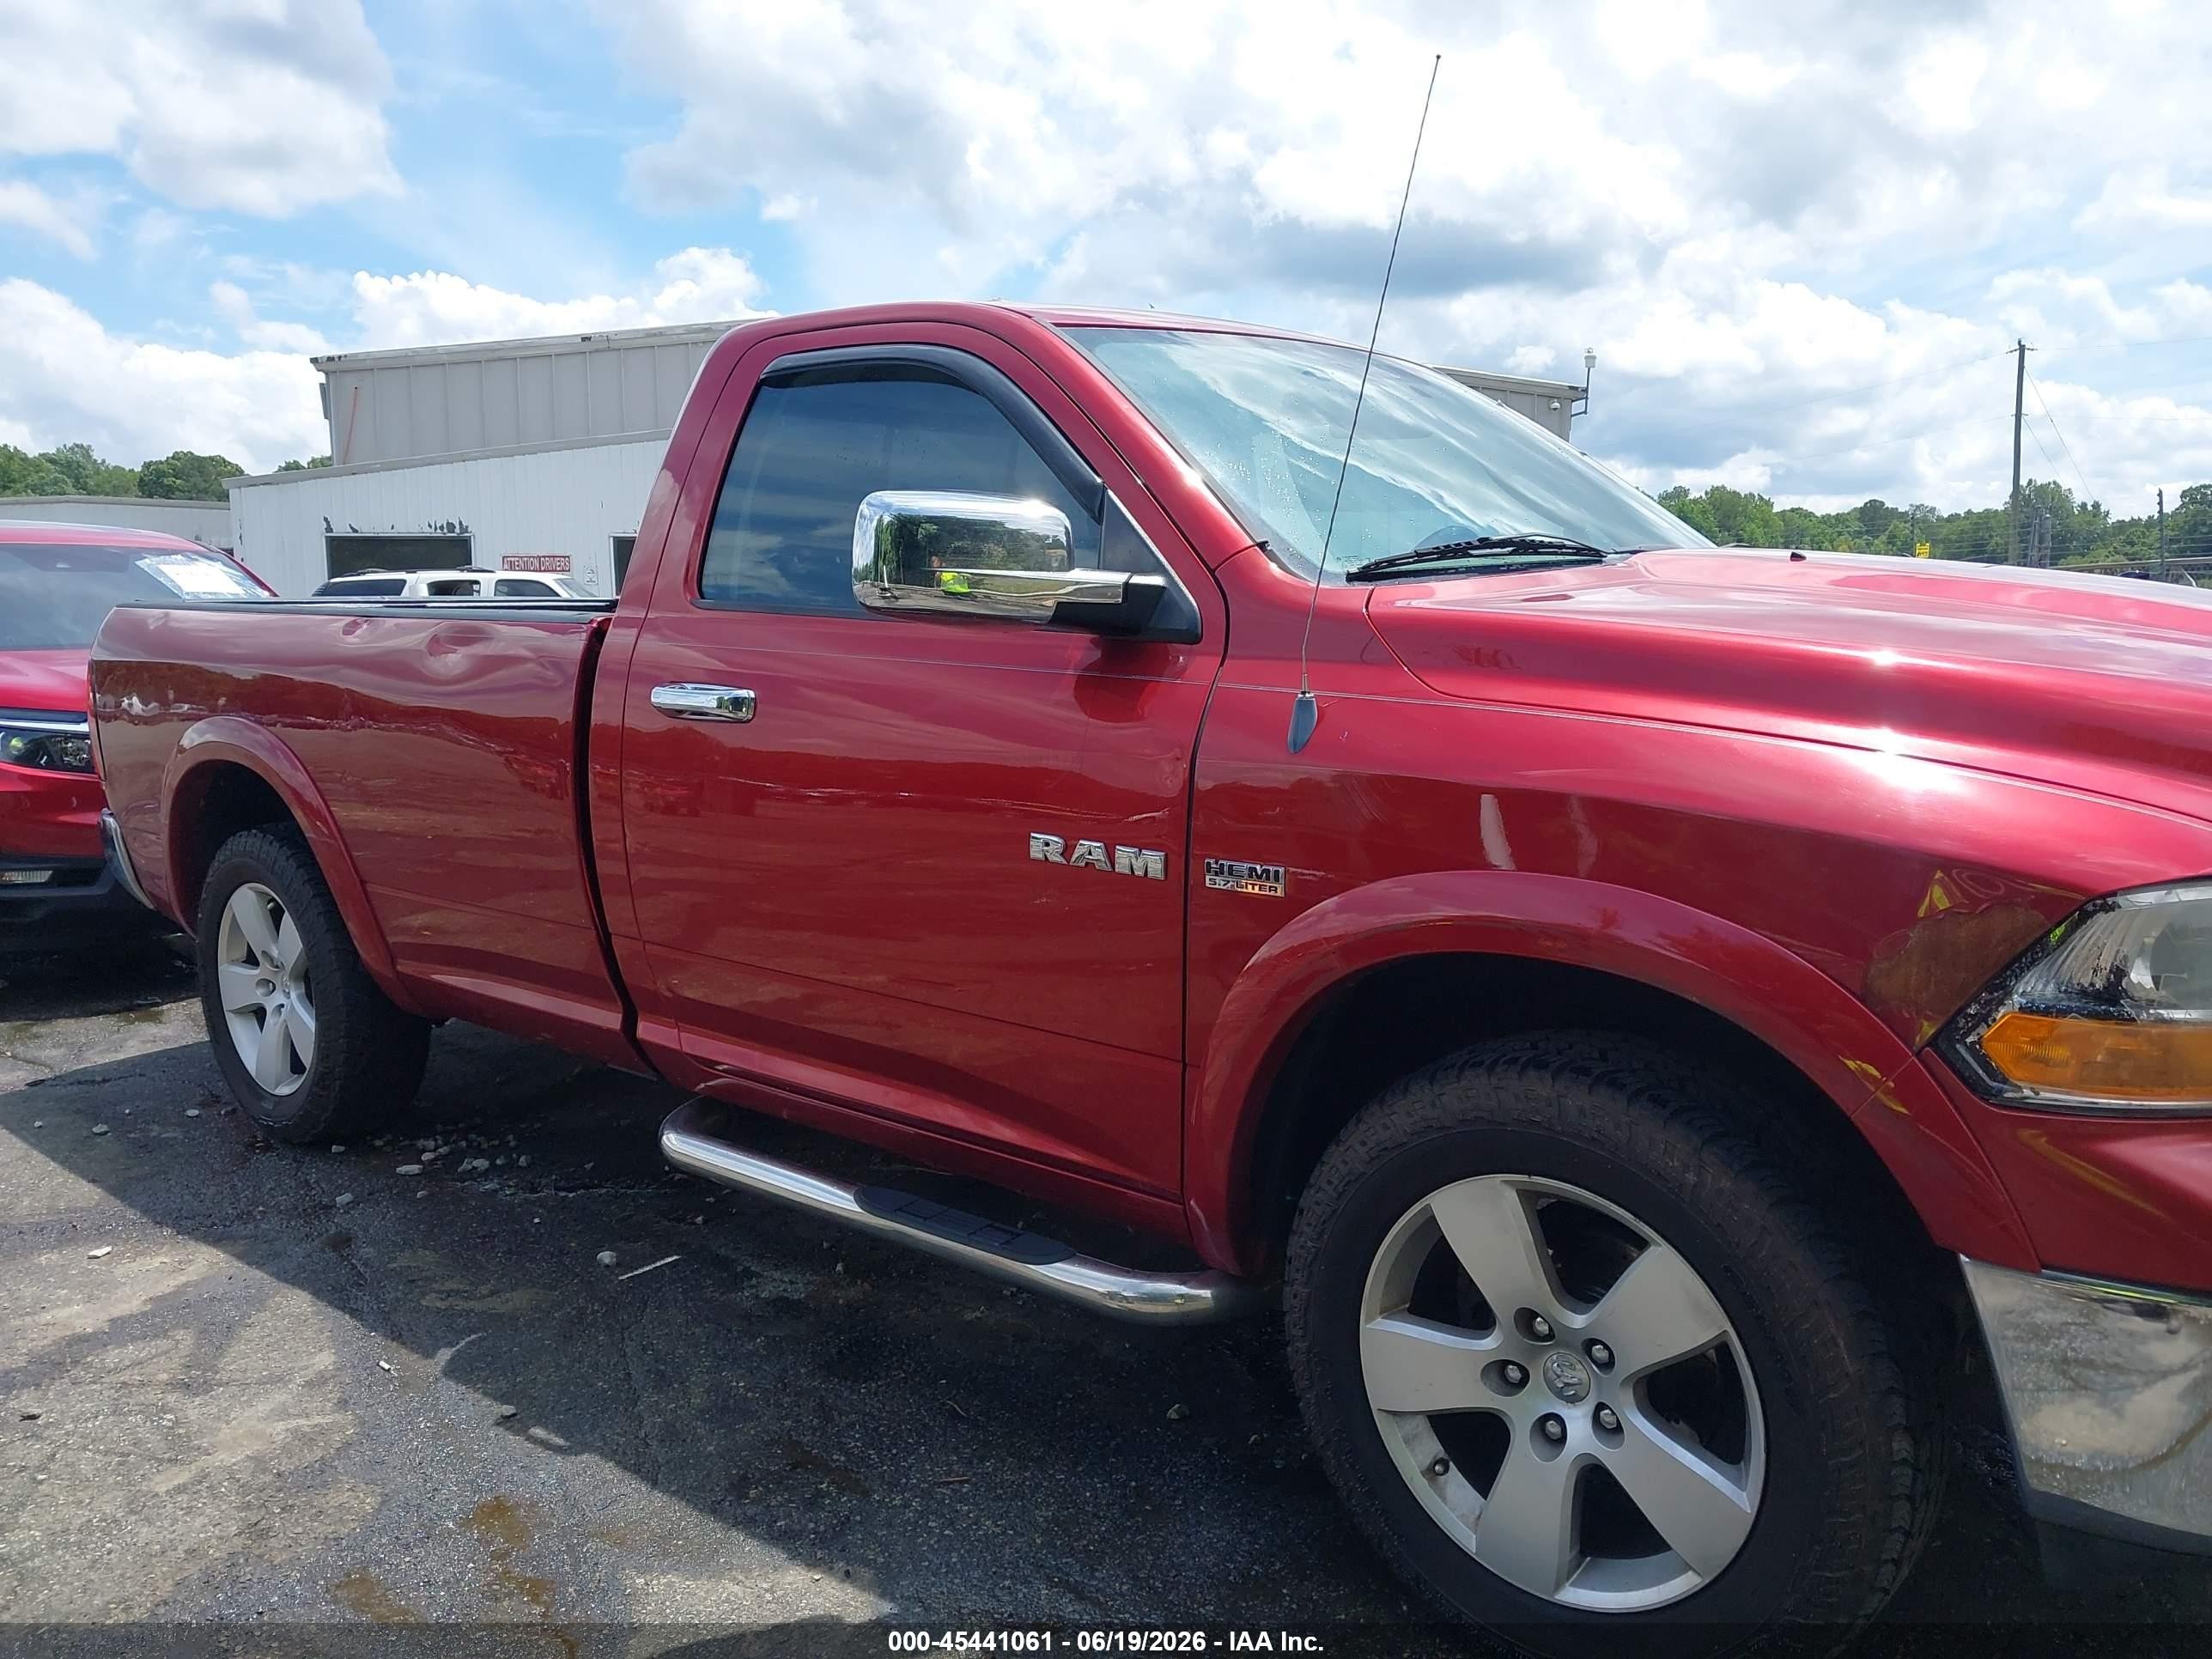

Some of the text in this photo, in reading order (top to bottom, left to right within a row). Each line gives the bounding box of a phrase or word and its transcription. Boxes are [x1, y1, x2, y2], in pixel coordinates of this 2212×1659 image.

[503, 557, 569, 571] ATTENTION DRIVERS
[1030, 831, 1166, 880] RAM
[1205, 858, 1285, 884] HEMI
[1208, 878, 1279, 895] 5.7 LITER
